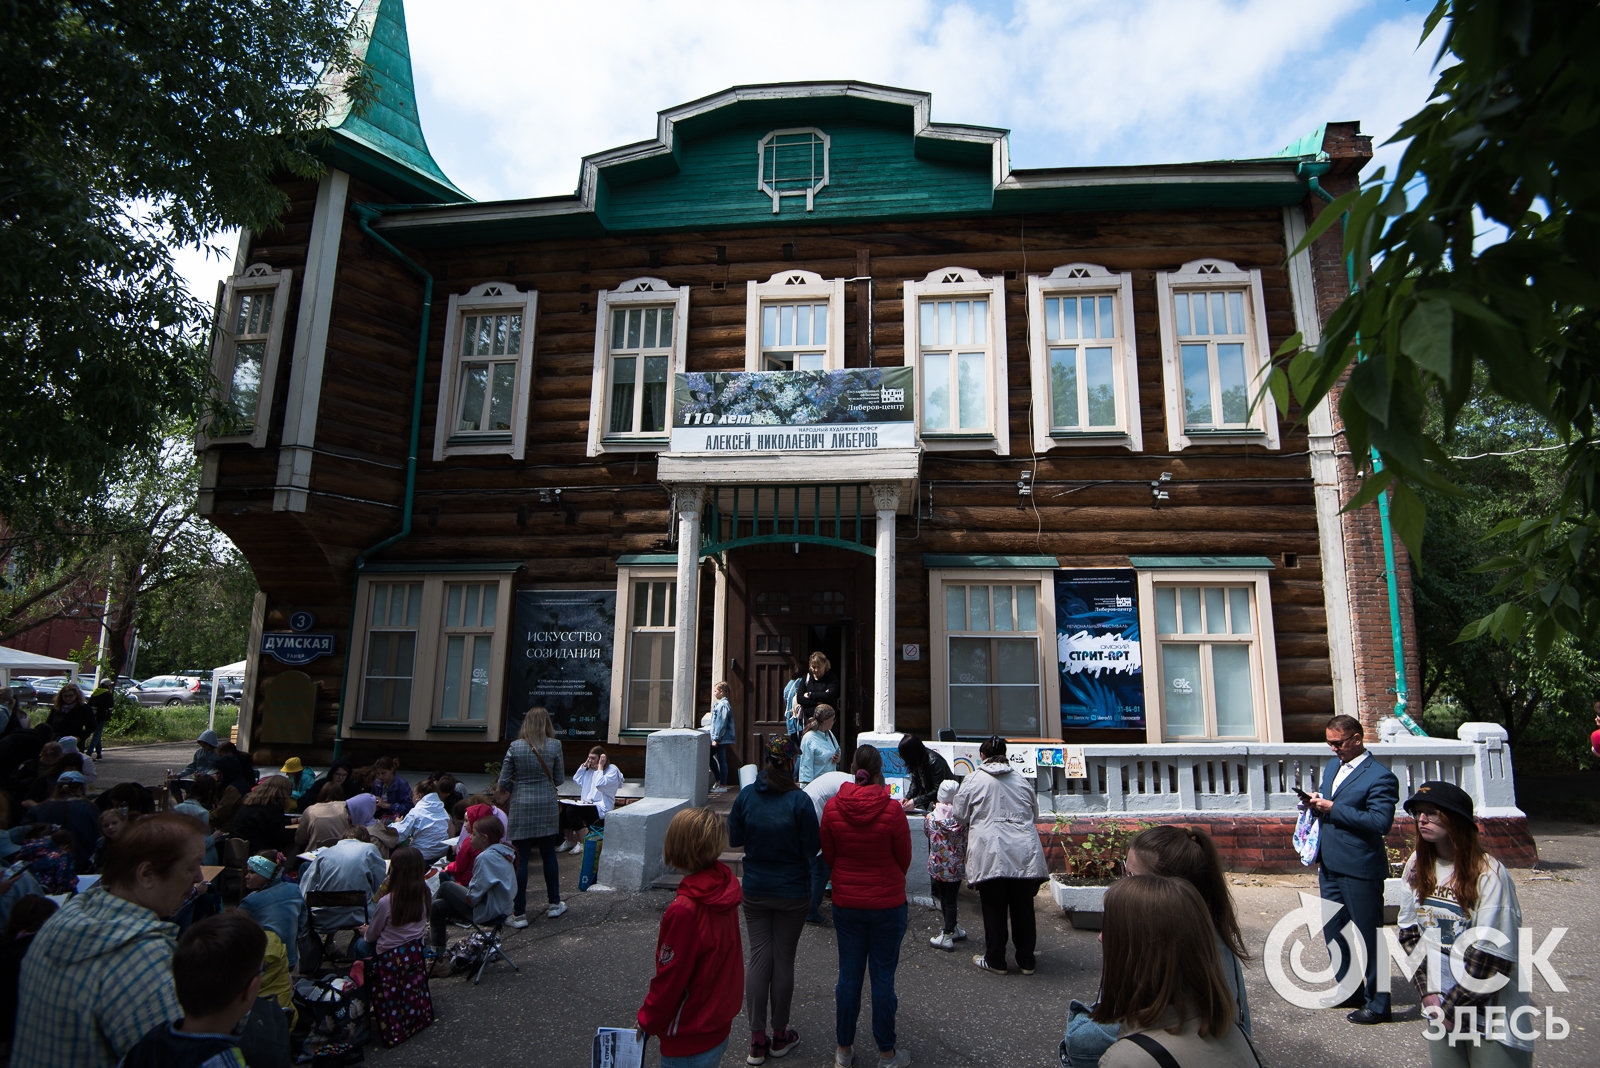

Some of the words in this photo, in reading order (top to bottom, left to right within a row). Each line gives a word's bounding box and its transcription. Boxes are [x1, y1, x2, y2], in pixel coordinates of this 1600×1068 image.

[847, 404, 905, 412] Либеров-центр
[683, 412, 715, 425] 110
[717, 414, 752, 425] лет
[705, 432, 751, 450] АЛЕКСЕЙ
[757, 432, 825, 450] НИКОЛАЕВИЧ
[831, 432, 878, 449] ЛИБЕРОВ
[296, 615, 306, 628] 3
[527, 631, 602, 642] ИСКУССТВО
[265, 637, 330, 649] ДУМСКАЯ
[526, 648, 601, 659] СОЗИДАНИЯ
